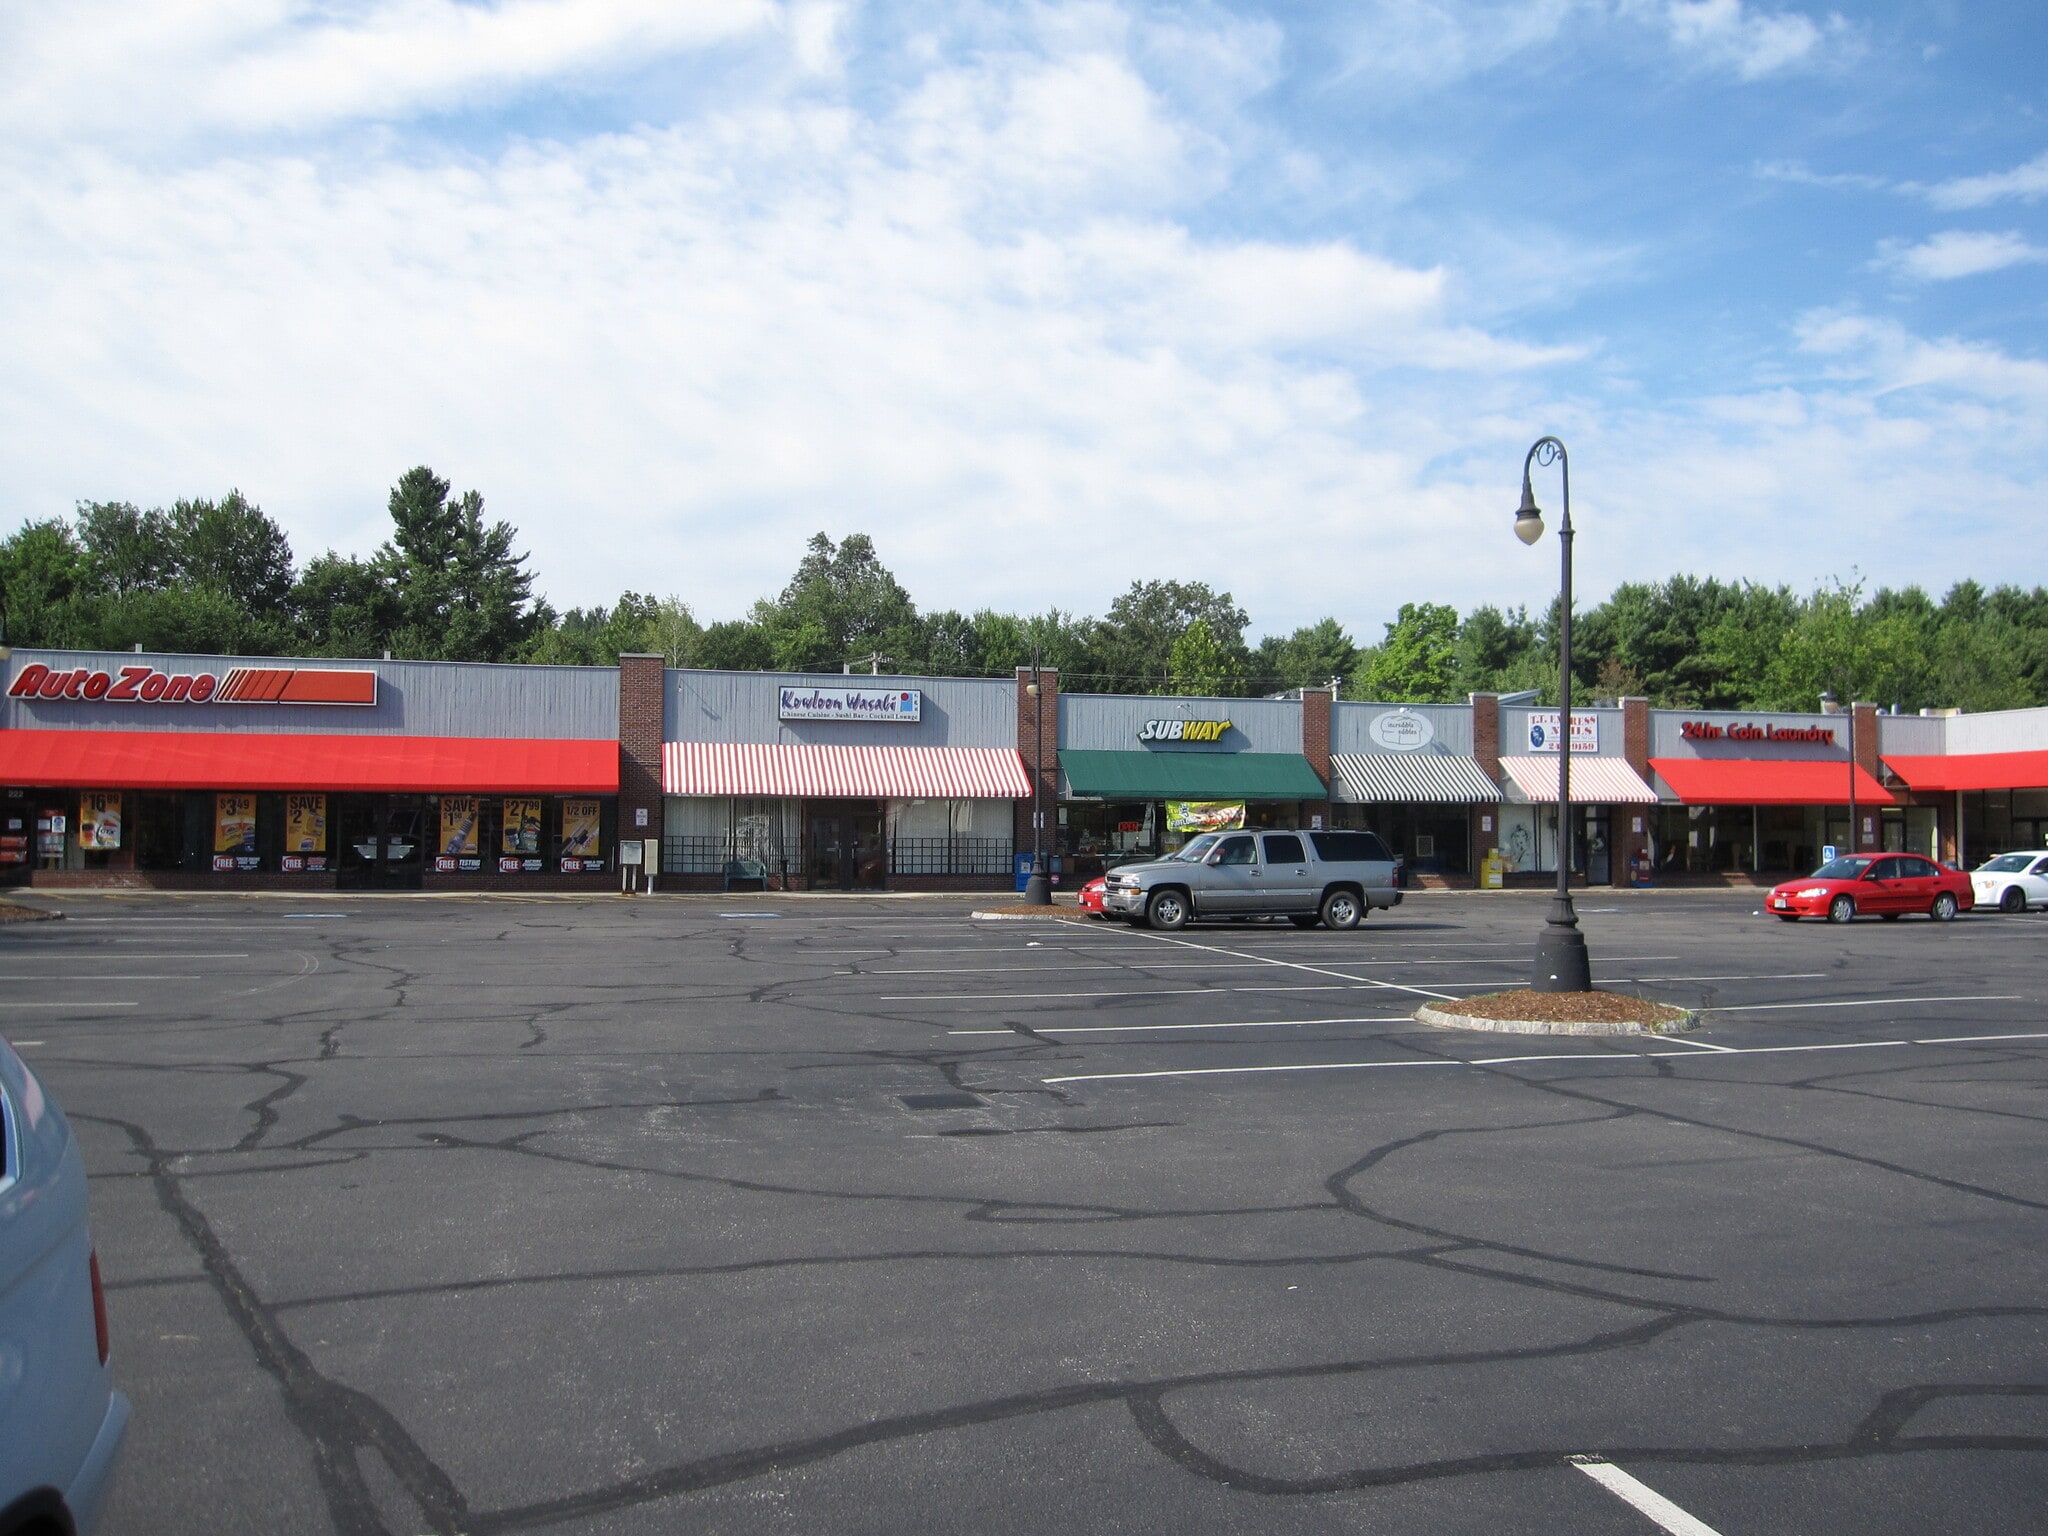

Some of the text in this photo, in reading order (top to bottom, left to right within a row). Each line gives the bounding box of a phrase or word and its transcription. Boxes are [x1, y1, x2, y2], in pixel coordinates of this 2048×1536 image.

[7, 663, 218, 702] AutoZone
[781, 690, 843, 710] Kowloon
[846, 692, 897, 712] Wasabi
[835, 711, 852, 719] Sushi
[1550, 715, 1596, 726] ERESS
[1139, 718, 1231, 741] SUBWAY
[1551, 726, 1593, 735] NILS
[1727, 722, 1764, 740] Coin
[1766, 723, 1835, 745] Laundry
[290, 796, 323, 809] SAVE
[444, 799, 475, 812] SAVE
[582, 806, 598, 816] OFF
[1119, 822, 1138, 831] OPEN
[217, 859, 234, 868] FREE
[285, 859, 302, 868] FREE
[438, 859, 455, 869] FREE
[502, 860, 519, 869] FREE
[564, 860, 580, 870] FREE
